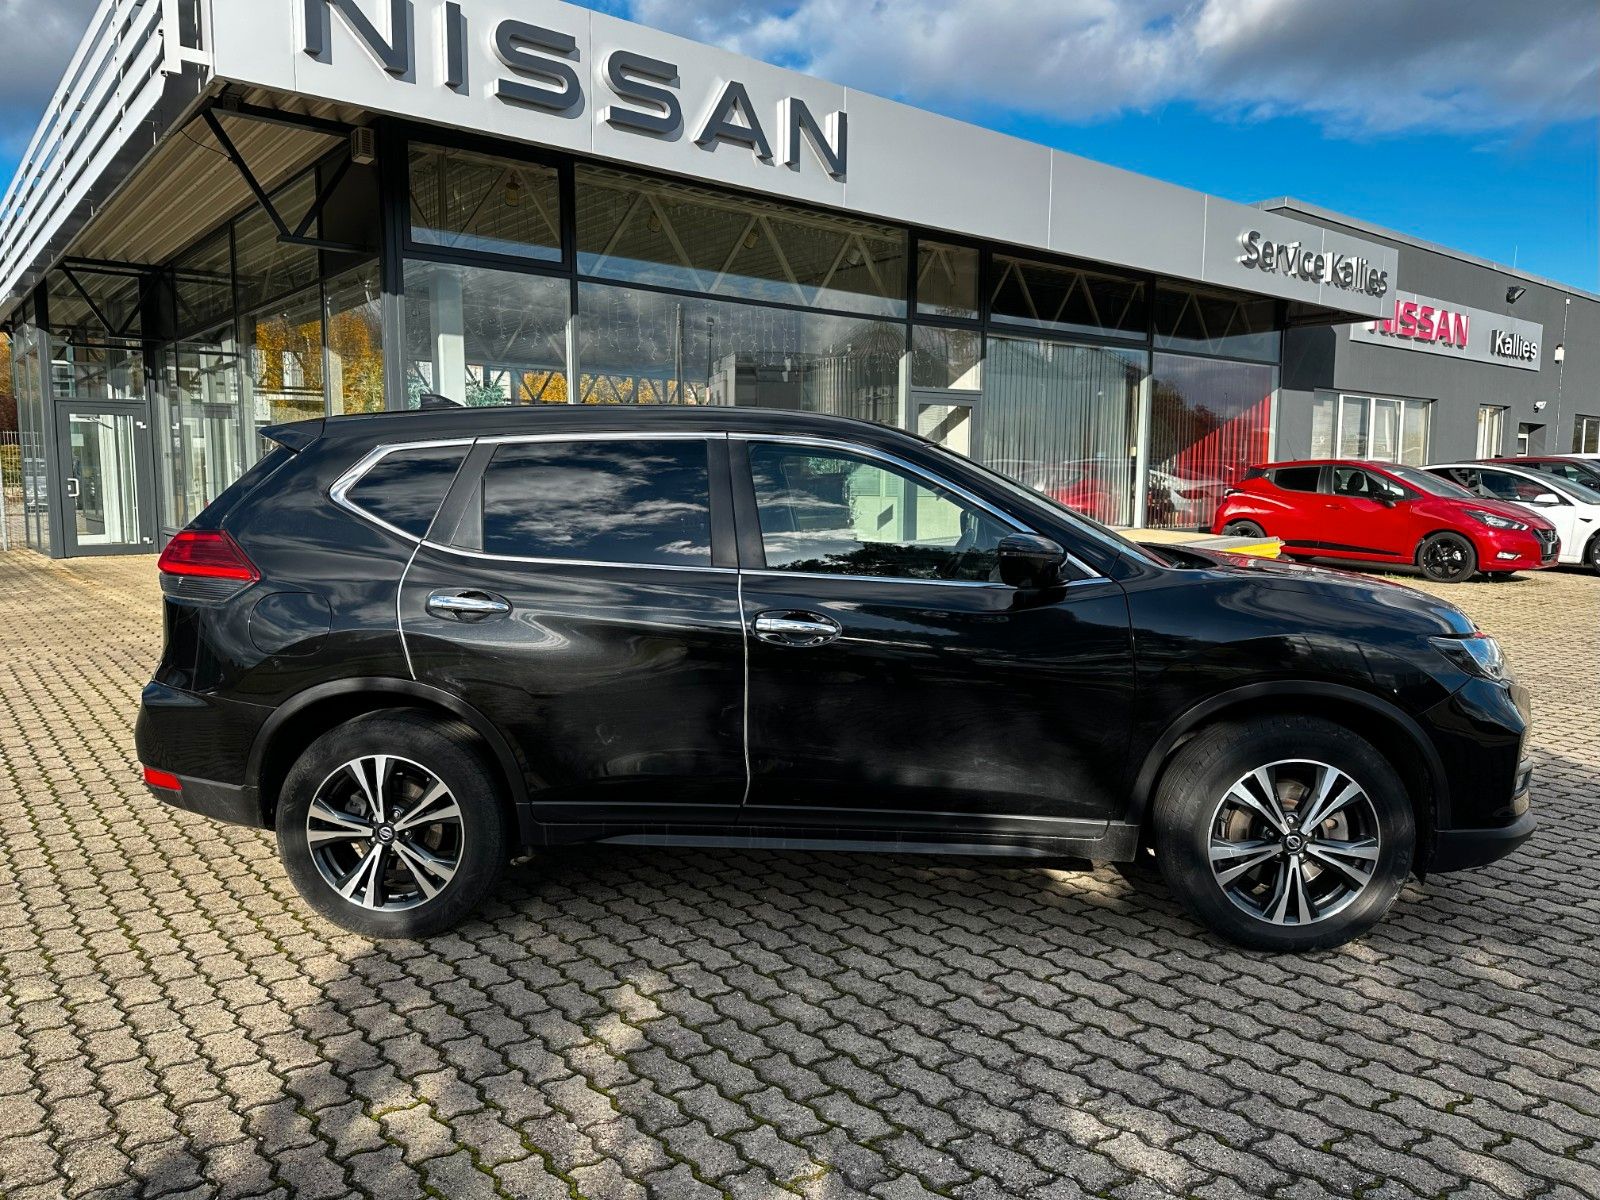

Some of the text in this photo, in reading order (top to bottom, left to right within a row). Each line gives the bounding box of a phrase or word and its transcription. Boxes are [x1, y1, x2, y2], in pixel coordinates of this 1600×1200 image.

[302, 0, 848, 183] NISSAN
[1240, 230, 1388, 297] Service Kallies
[1494, 329, 1538, 359] Kallies
